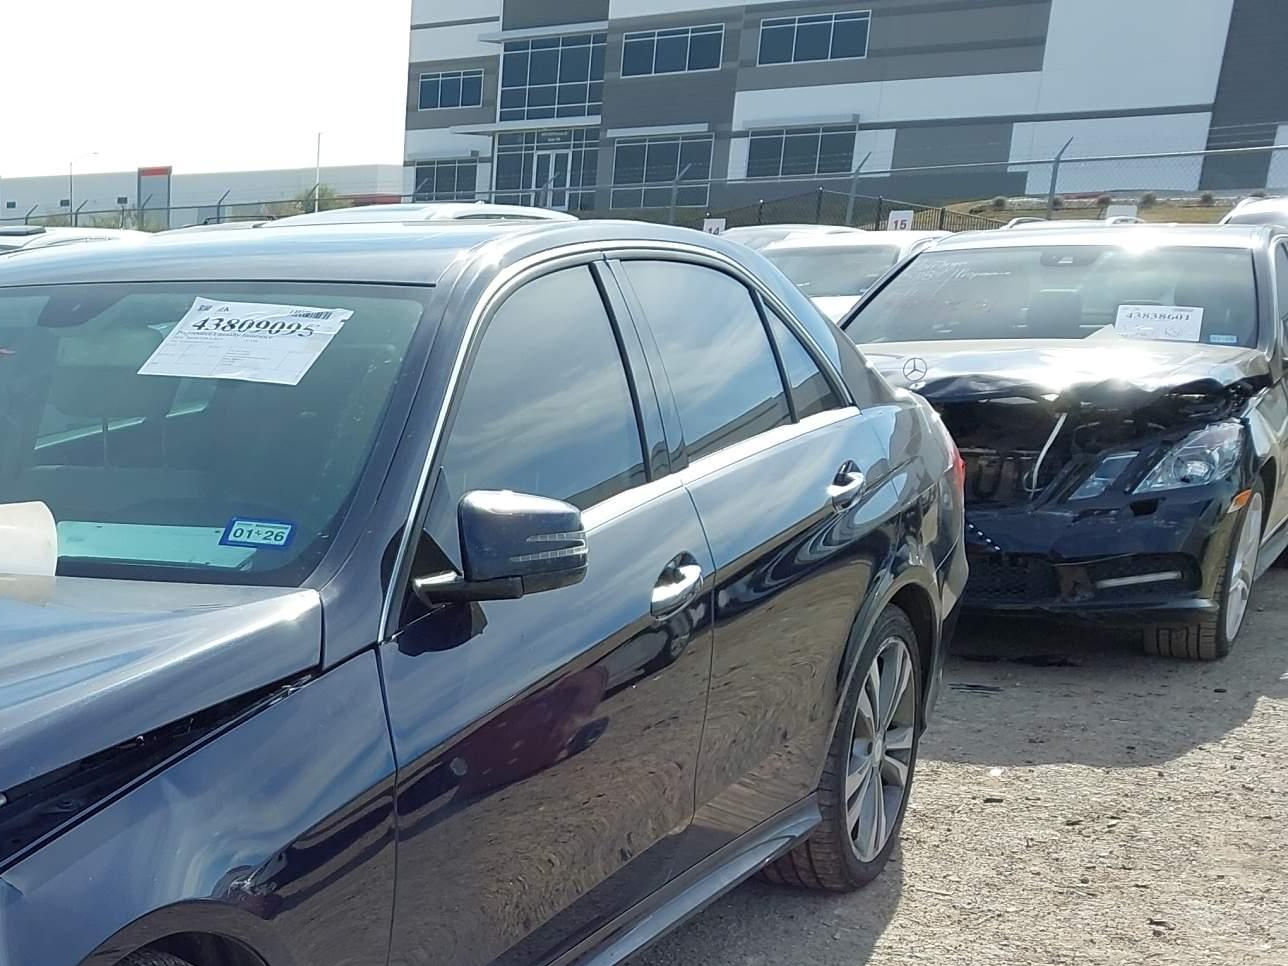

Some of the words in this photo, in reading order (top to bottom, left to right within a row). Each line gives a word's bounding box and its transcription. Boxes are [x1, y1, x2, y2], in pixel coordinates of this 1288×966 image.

[893, 219, 908, 230] 15
[1126, 312, 1191, 321] 43838601
[192, 317, 320, 337] 43809095
[232, 527, 253, 540] 01
[262, 530, 285, 542] 26
